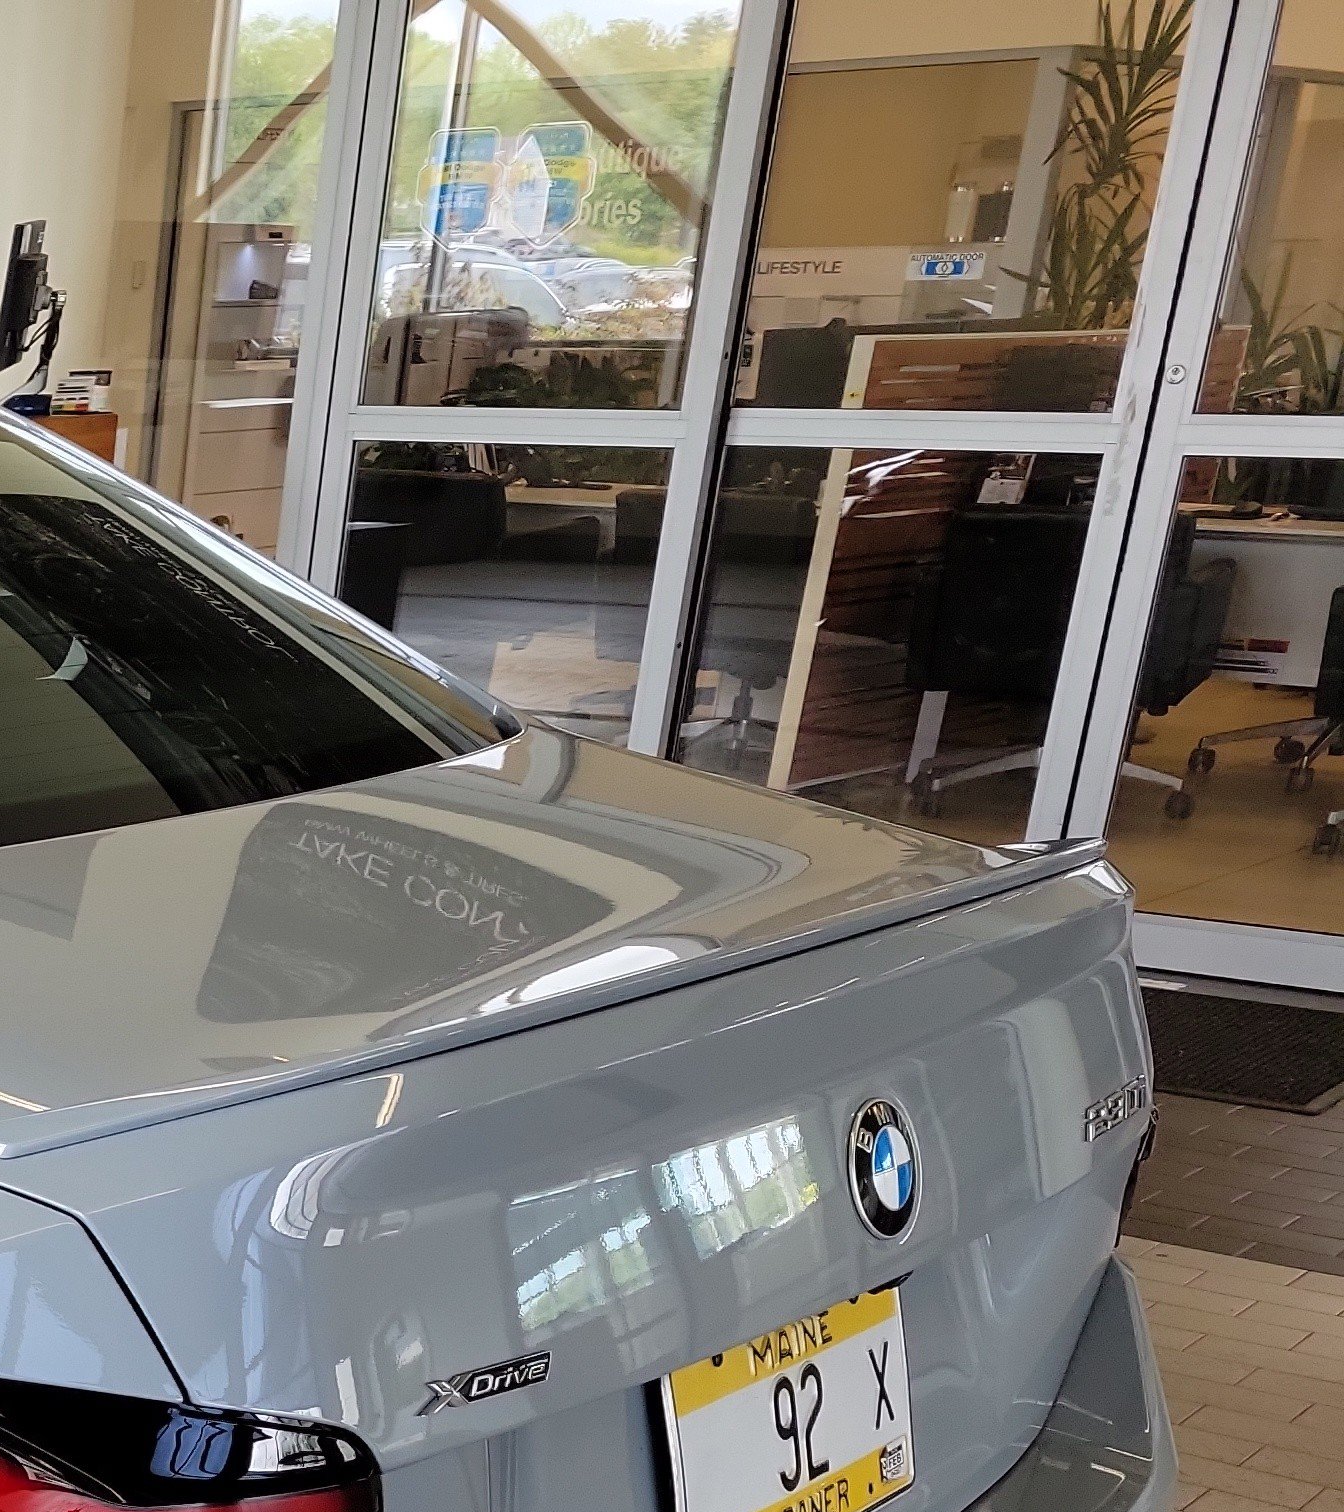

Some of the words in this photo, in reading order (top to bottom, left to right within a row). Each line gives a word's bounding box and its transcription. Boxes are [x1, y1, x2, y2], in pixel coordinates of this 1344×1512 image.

[911, 253, 958, 261] AUTOMATIC
[960, 252, 984, 261] DOOR
[757, 260, 843, 274] LIFESTYLE
[749, 1310, 833, 1377] MAINE
[773, 1362, 830, 1492] 92
[868, 1340, 895, 1431] X
[888, 1453, 902, 1469] FEB
